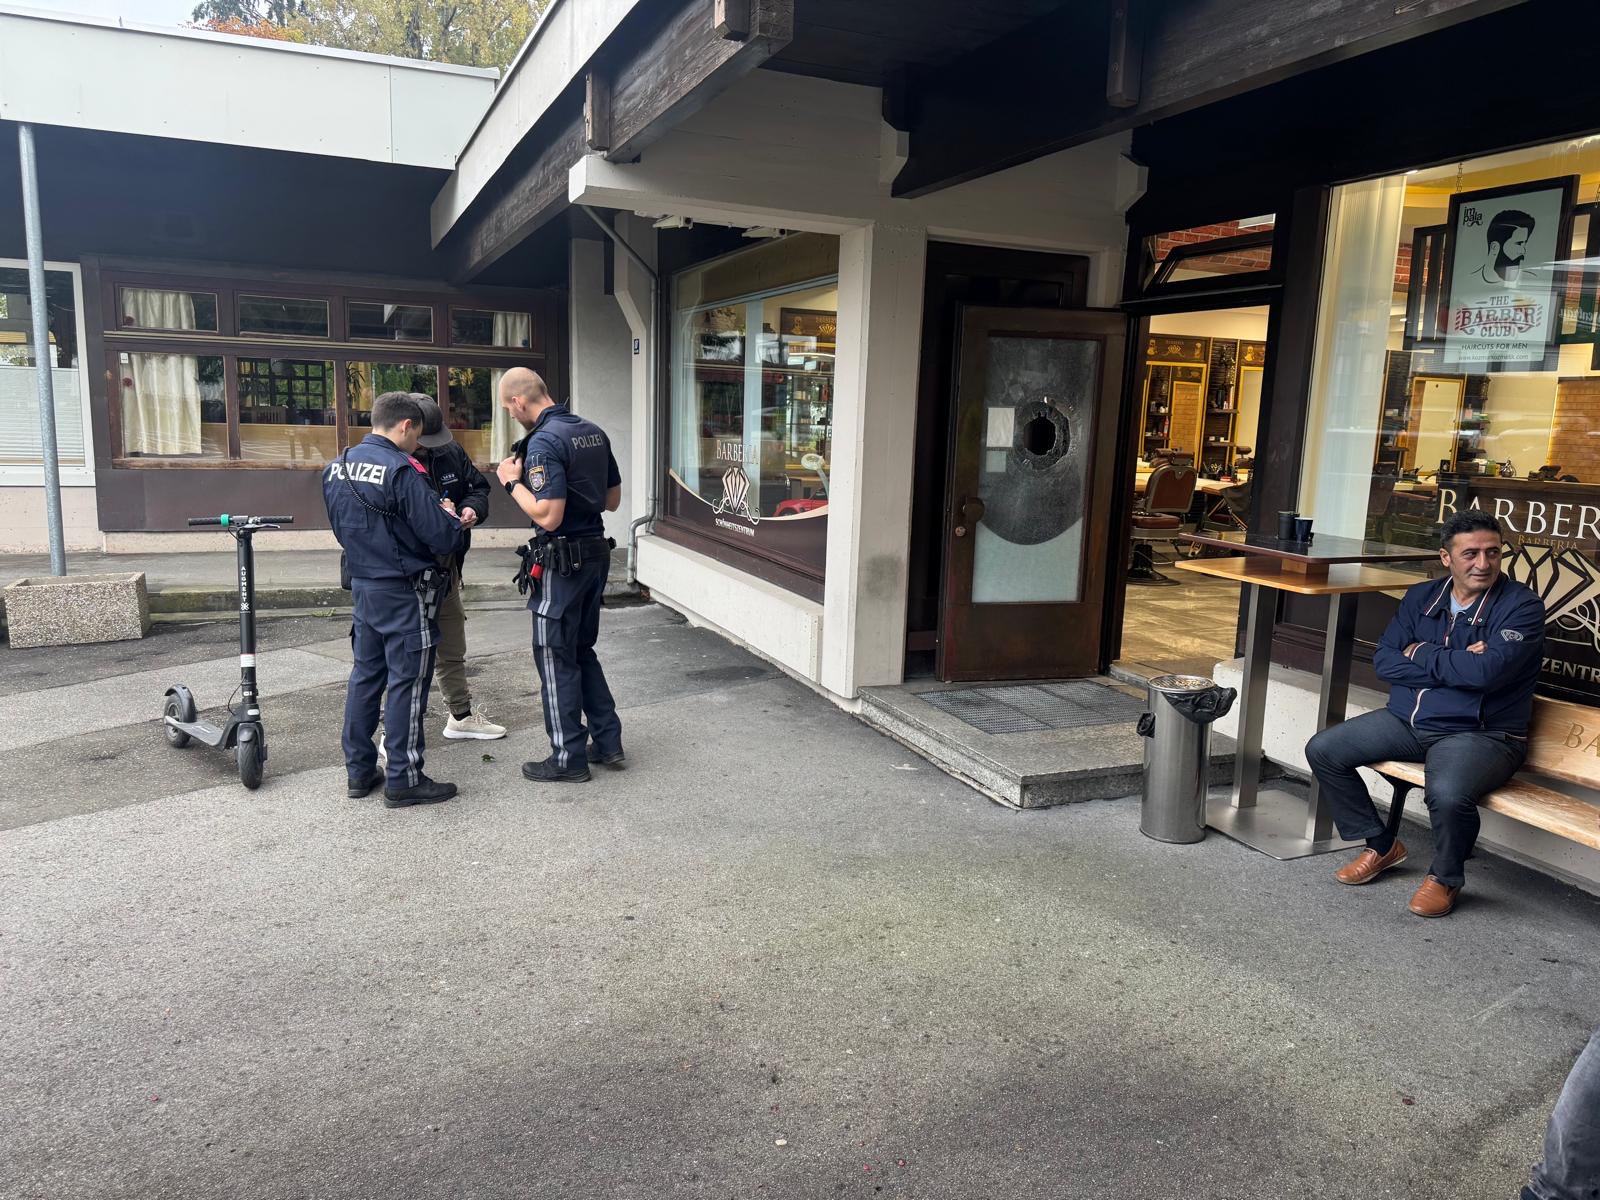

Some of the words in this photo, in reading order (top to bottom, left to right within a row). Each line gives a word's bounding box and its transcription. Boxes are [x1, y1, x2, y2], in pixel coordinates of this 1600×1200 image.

[1489, 295, 1509, 306] THE
[1460, 306, 1536, 327] BARBER
[1480, 325, 1511, 337] CLUB
[1496, 342, 1510, 350] FOR
[571, 433, 604, 450] POLIZEI
